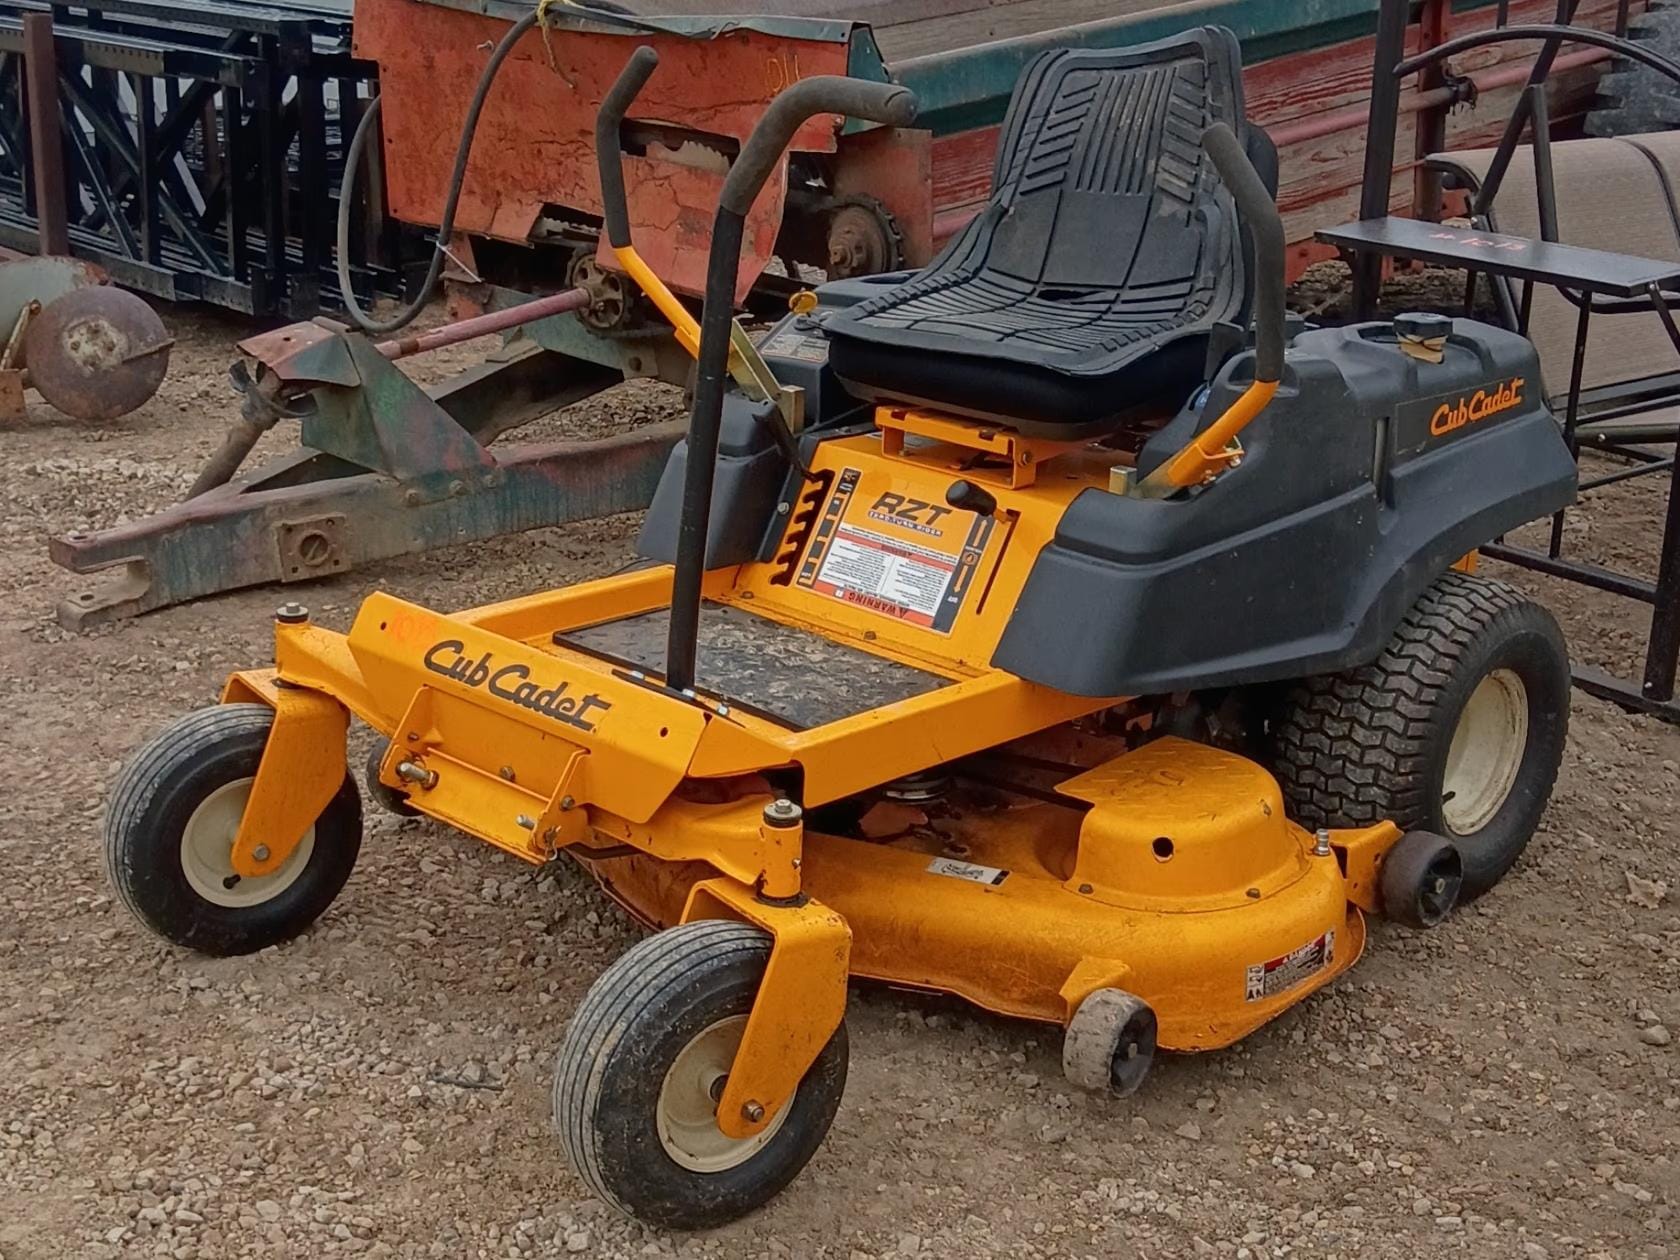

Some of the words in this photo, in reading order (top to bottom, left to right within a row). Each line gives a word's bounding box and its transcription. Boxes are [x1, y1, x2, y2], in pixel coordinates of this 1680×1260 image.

[1430, 397, 1468, 437] Cub
[1468, 377, 1526, 421] Cadet
[871, 491, 953, 526] RZT
[848, 591, 896, 614] WARNING
[424, 639, 492, 687] Cub
[488, 663, 612, 732] Cadet
